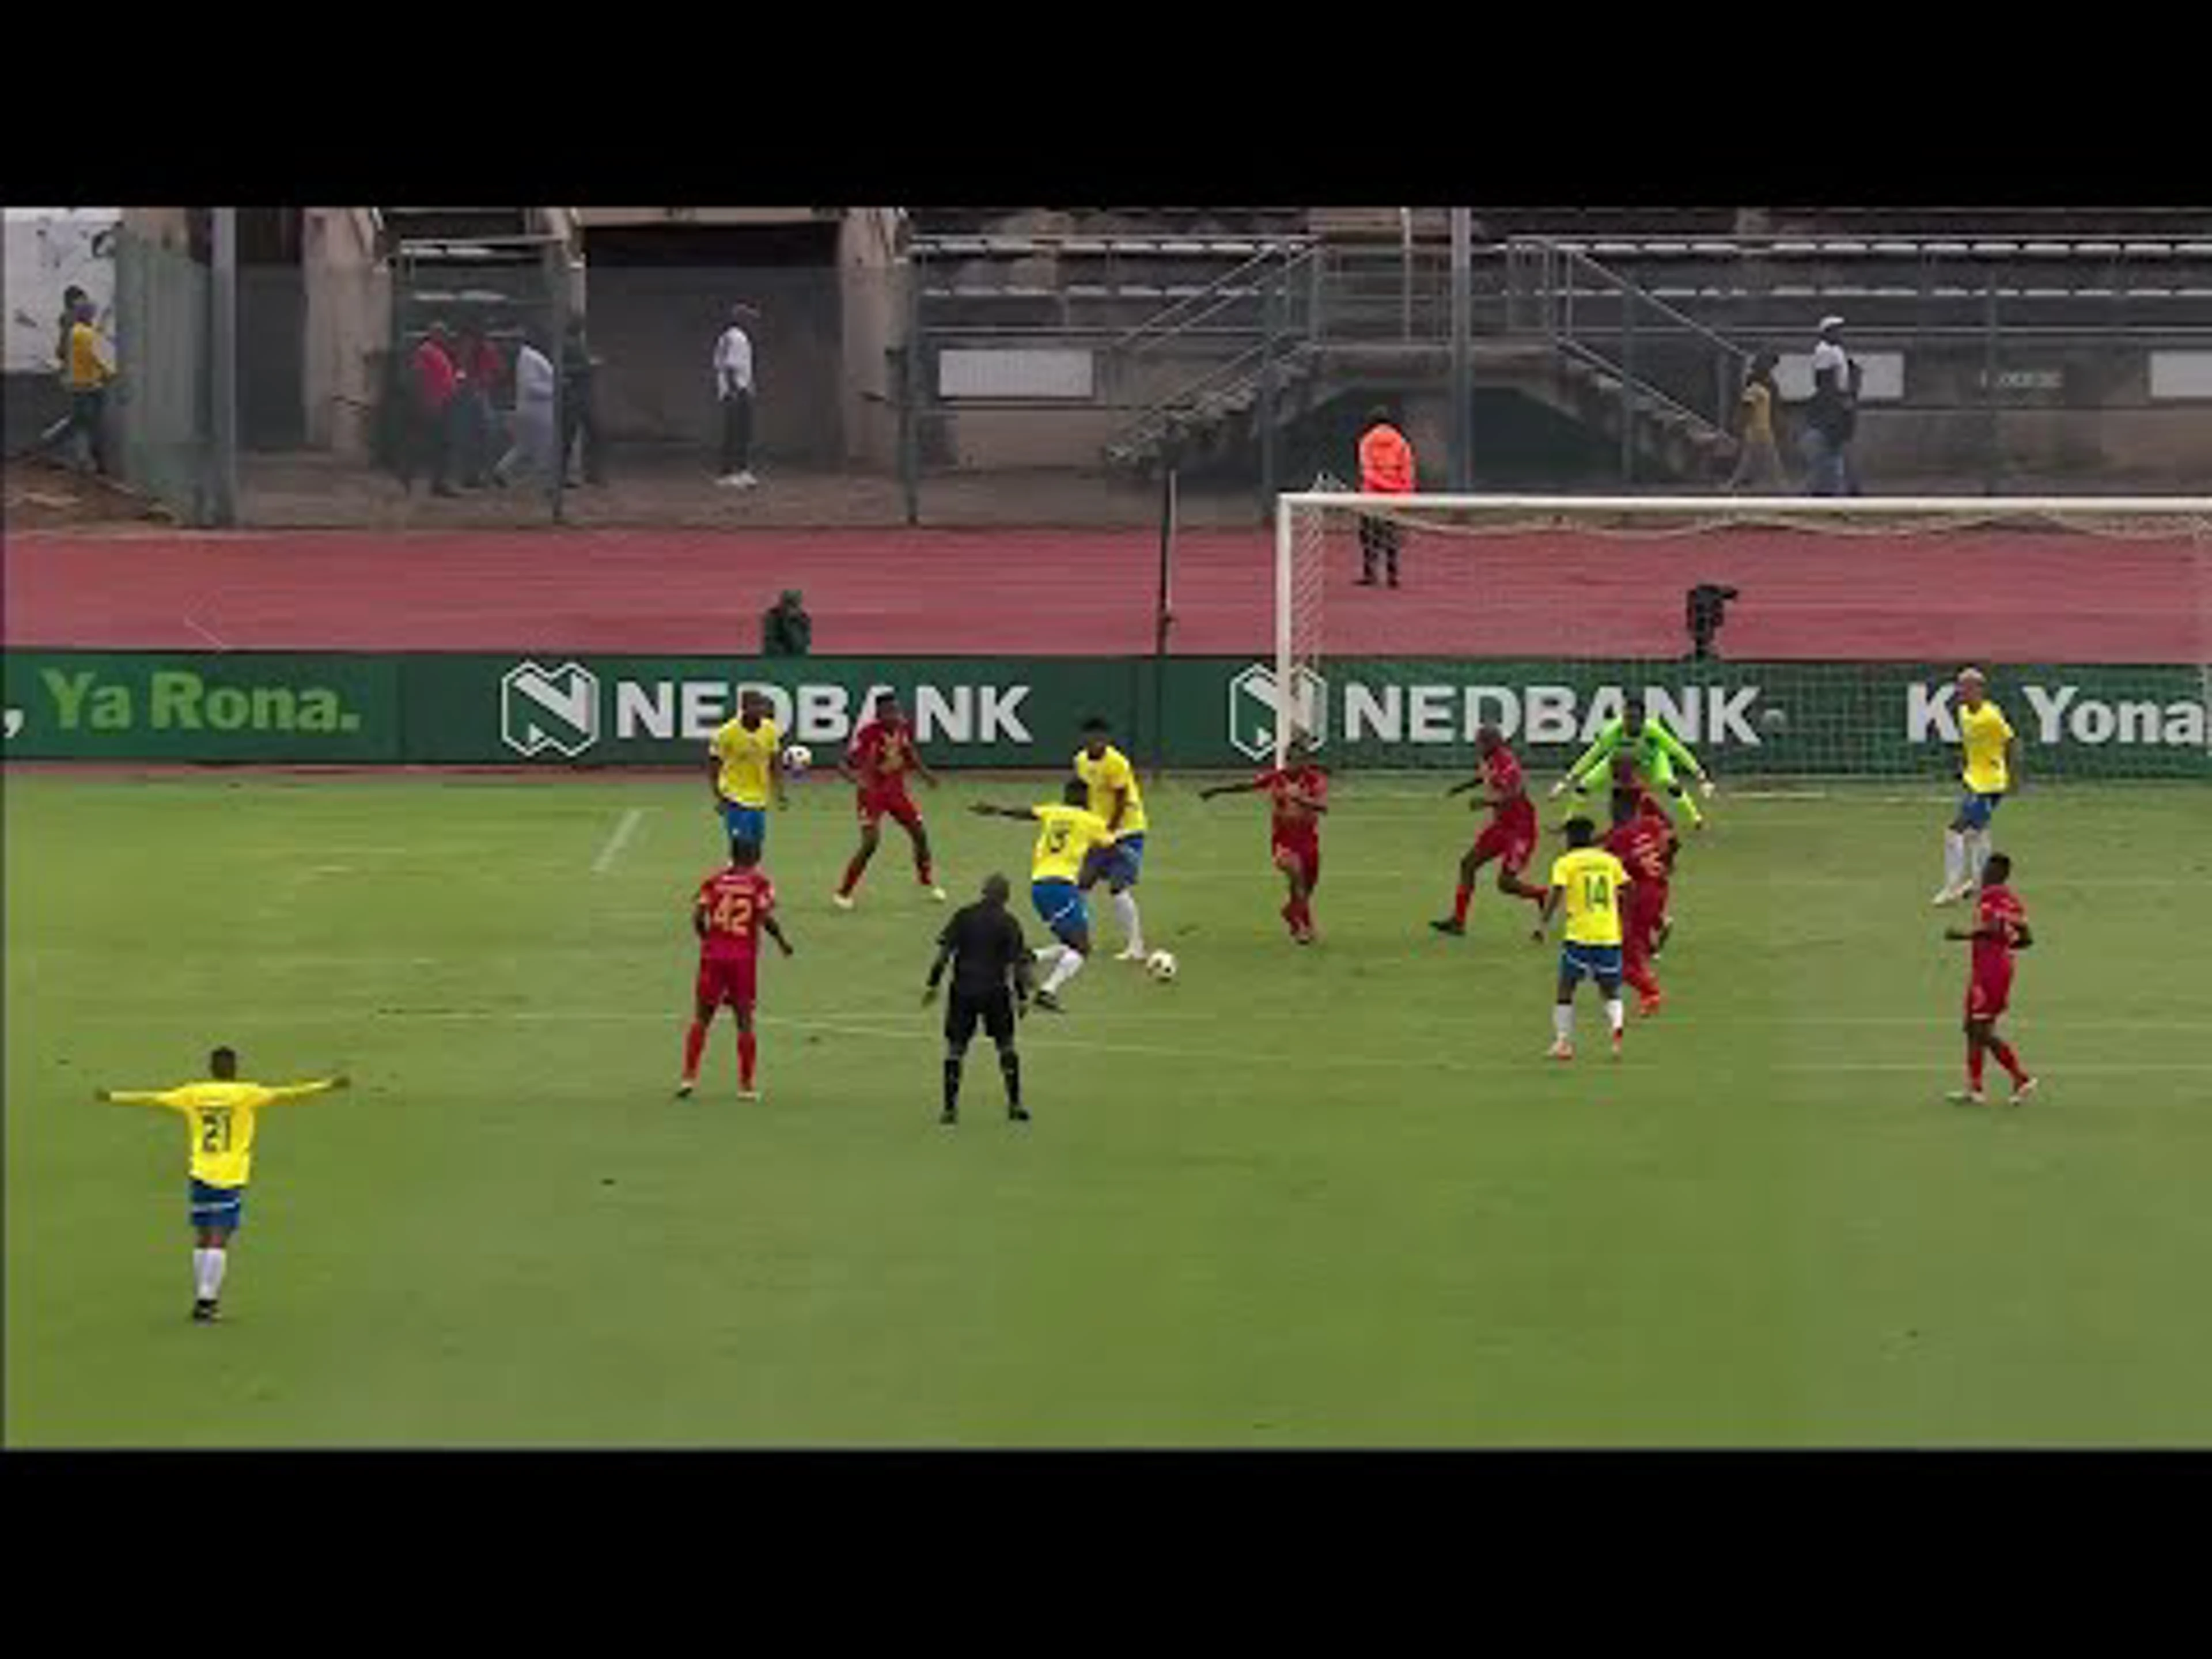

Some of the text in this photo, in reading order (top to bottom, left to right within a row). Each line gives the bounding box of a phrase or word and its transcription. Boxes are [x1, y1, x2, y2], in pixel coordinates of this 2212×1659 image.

[40, 668, 131, 729] Ya
[151, 671, 361, 730] Rona.
[1345, 684, 1762, 745] NEDBANK
[1585, 874, 1608, 912] 14
[713, 894, 752, 936] 42
[202, 1112, 231, 1153] 21
